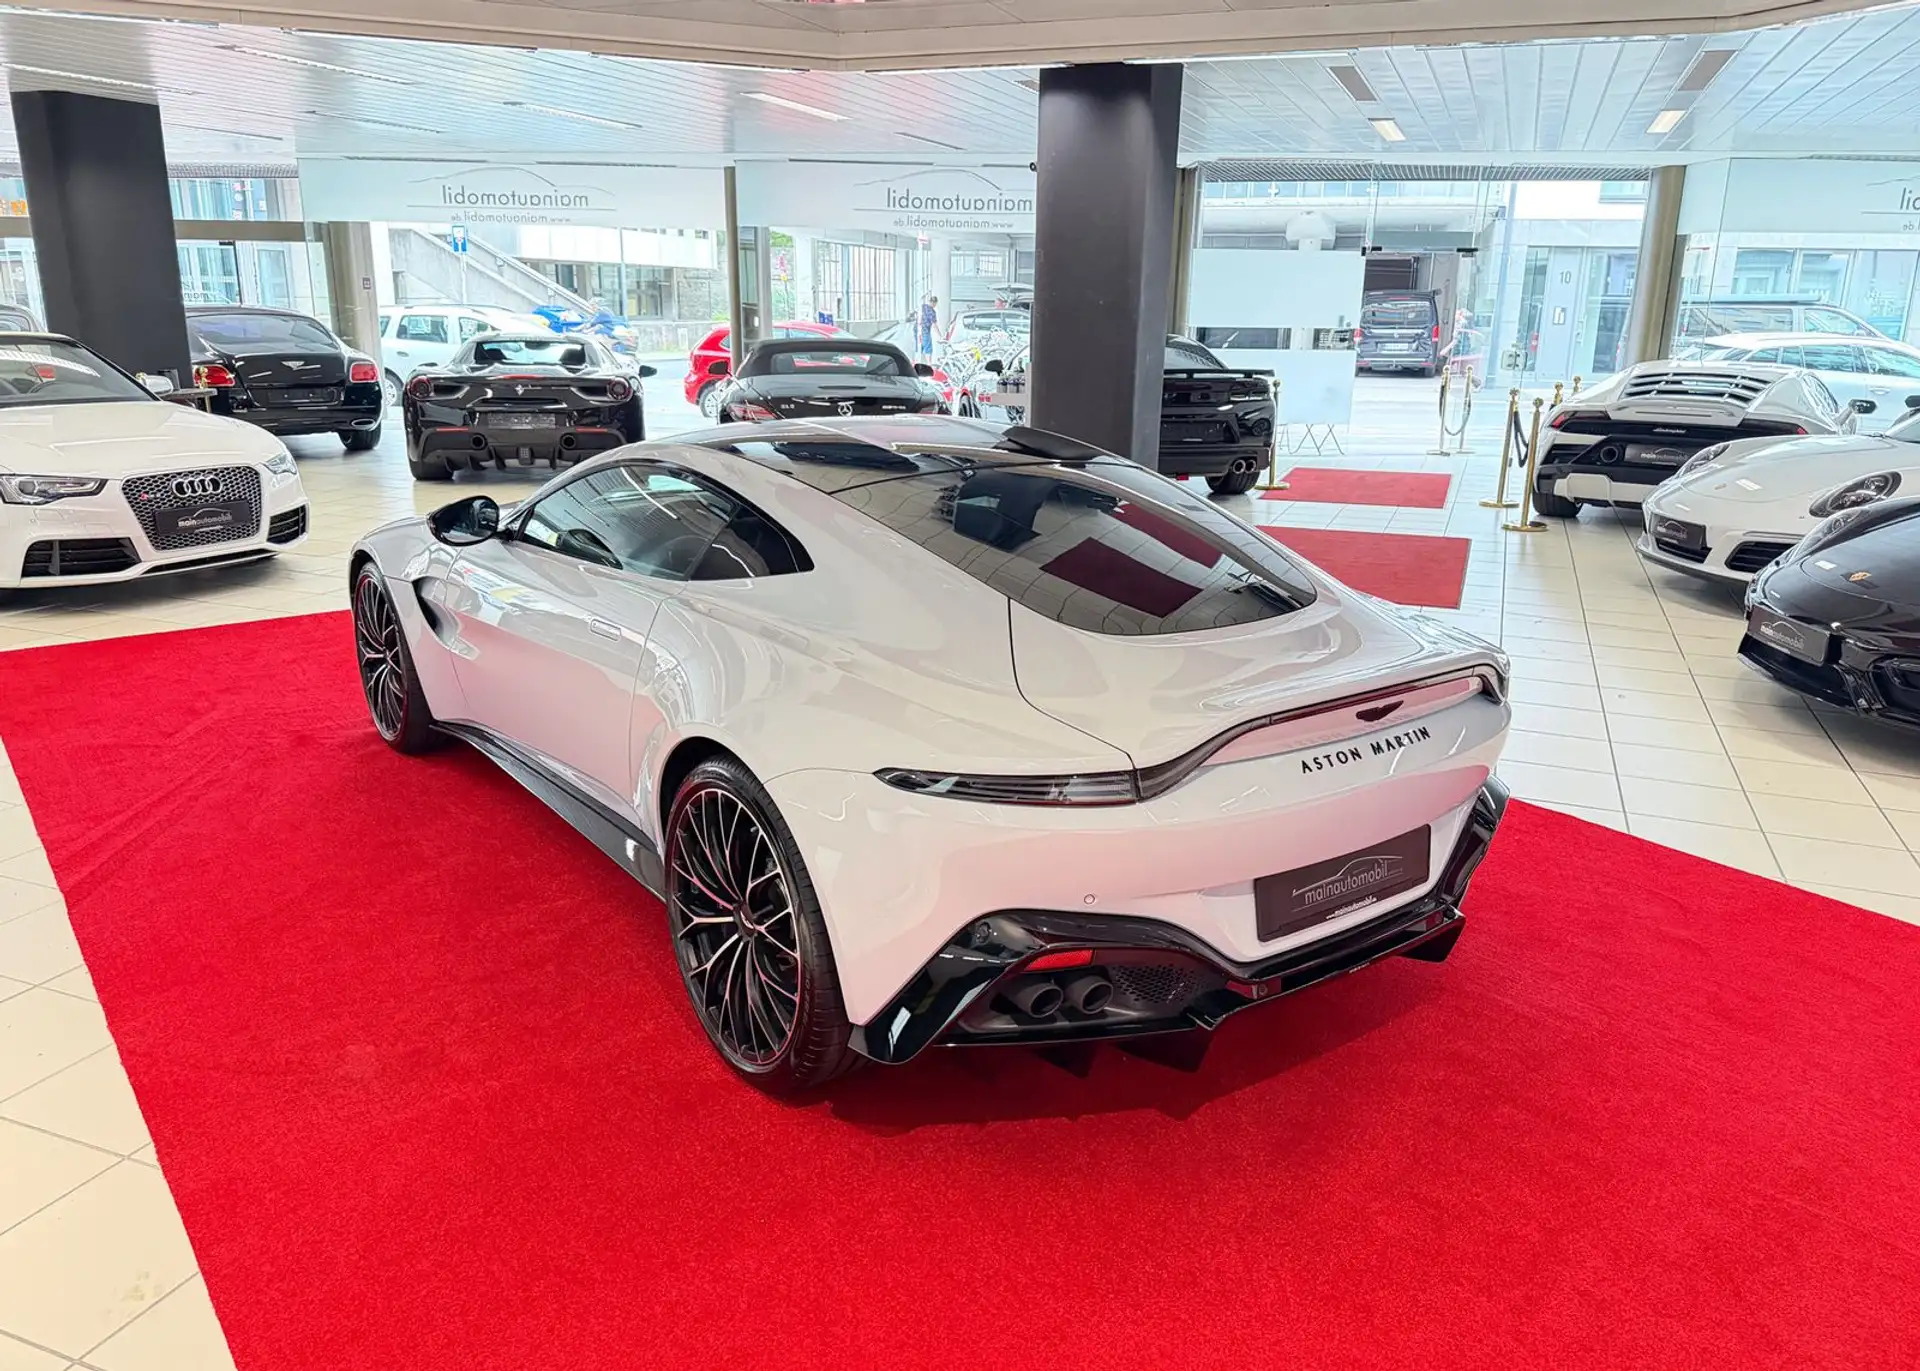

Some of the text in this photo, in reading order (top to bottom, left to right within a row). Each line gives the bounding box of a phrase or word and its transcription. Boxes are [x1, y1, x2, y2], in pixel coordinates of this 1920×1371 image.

[1560, 270, 1571, 284] 10
[1301, 726, 1432, 774] ASTON MARTIN
[1304, 859, 1389, 905] mainautomobil
